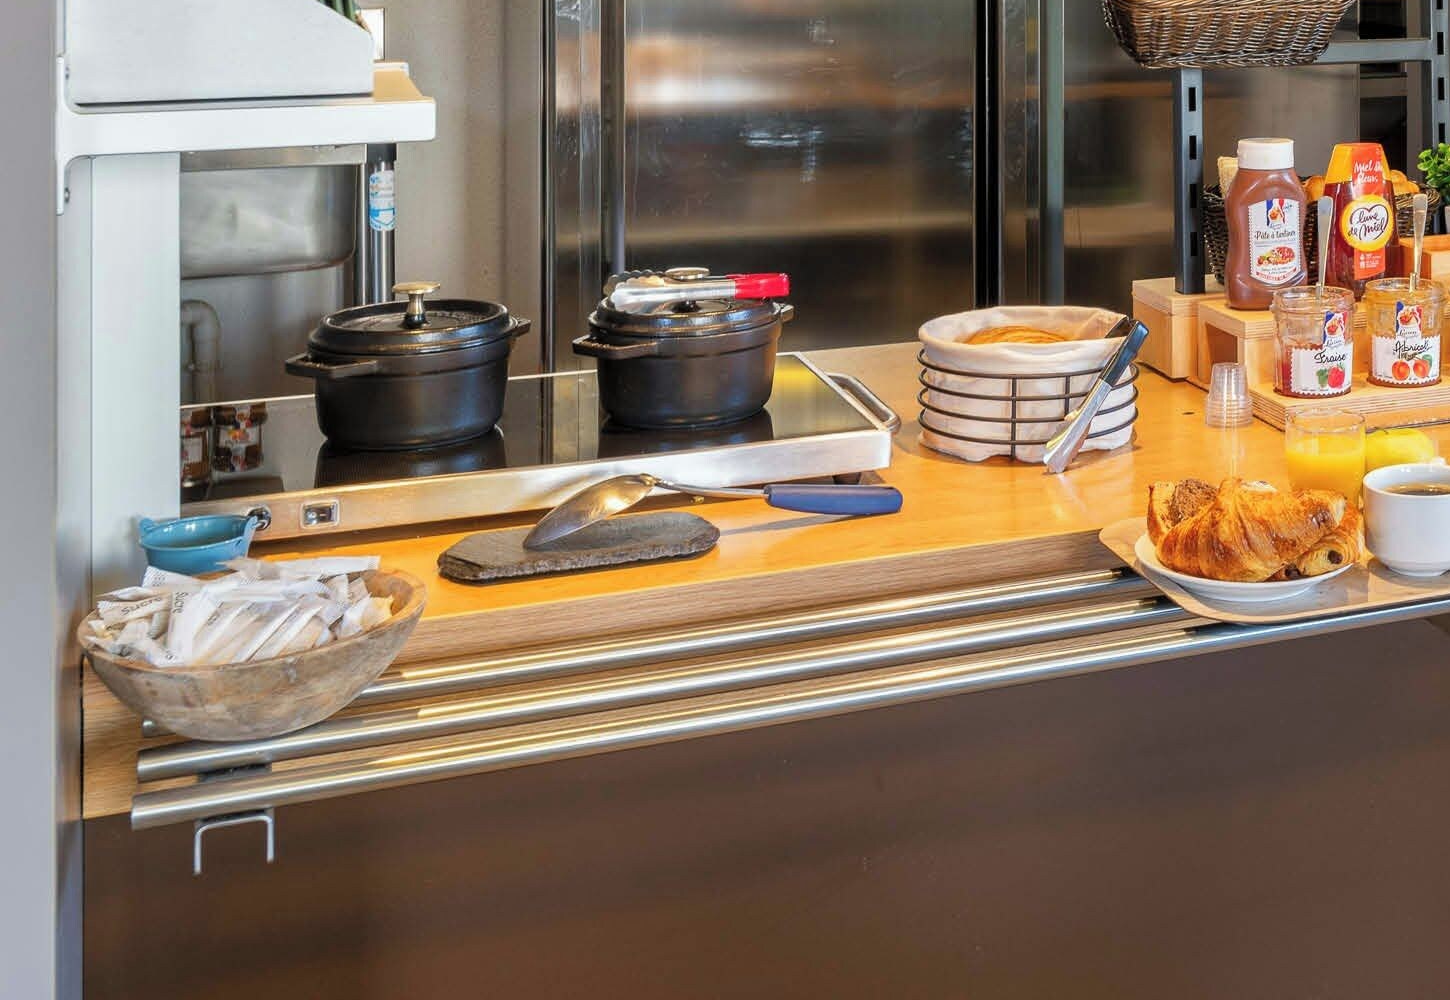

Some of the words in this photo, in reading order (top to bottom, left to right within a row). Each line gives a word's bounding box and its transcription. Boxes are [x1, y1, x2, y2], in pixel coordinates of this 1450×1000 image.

[1354, 160, 1373, 173] Miel
[1254, 230, 1270, 240] Pâte
[1314, 349, 1347, 364] Fraise
